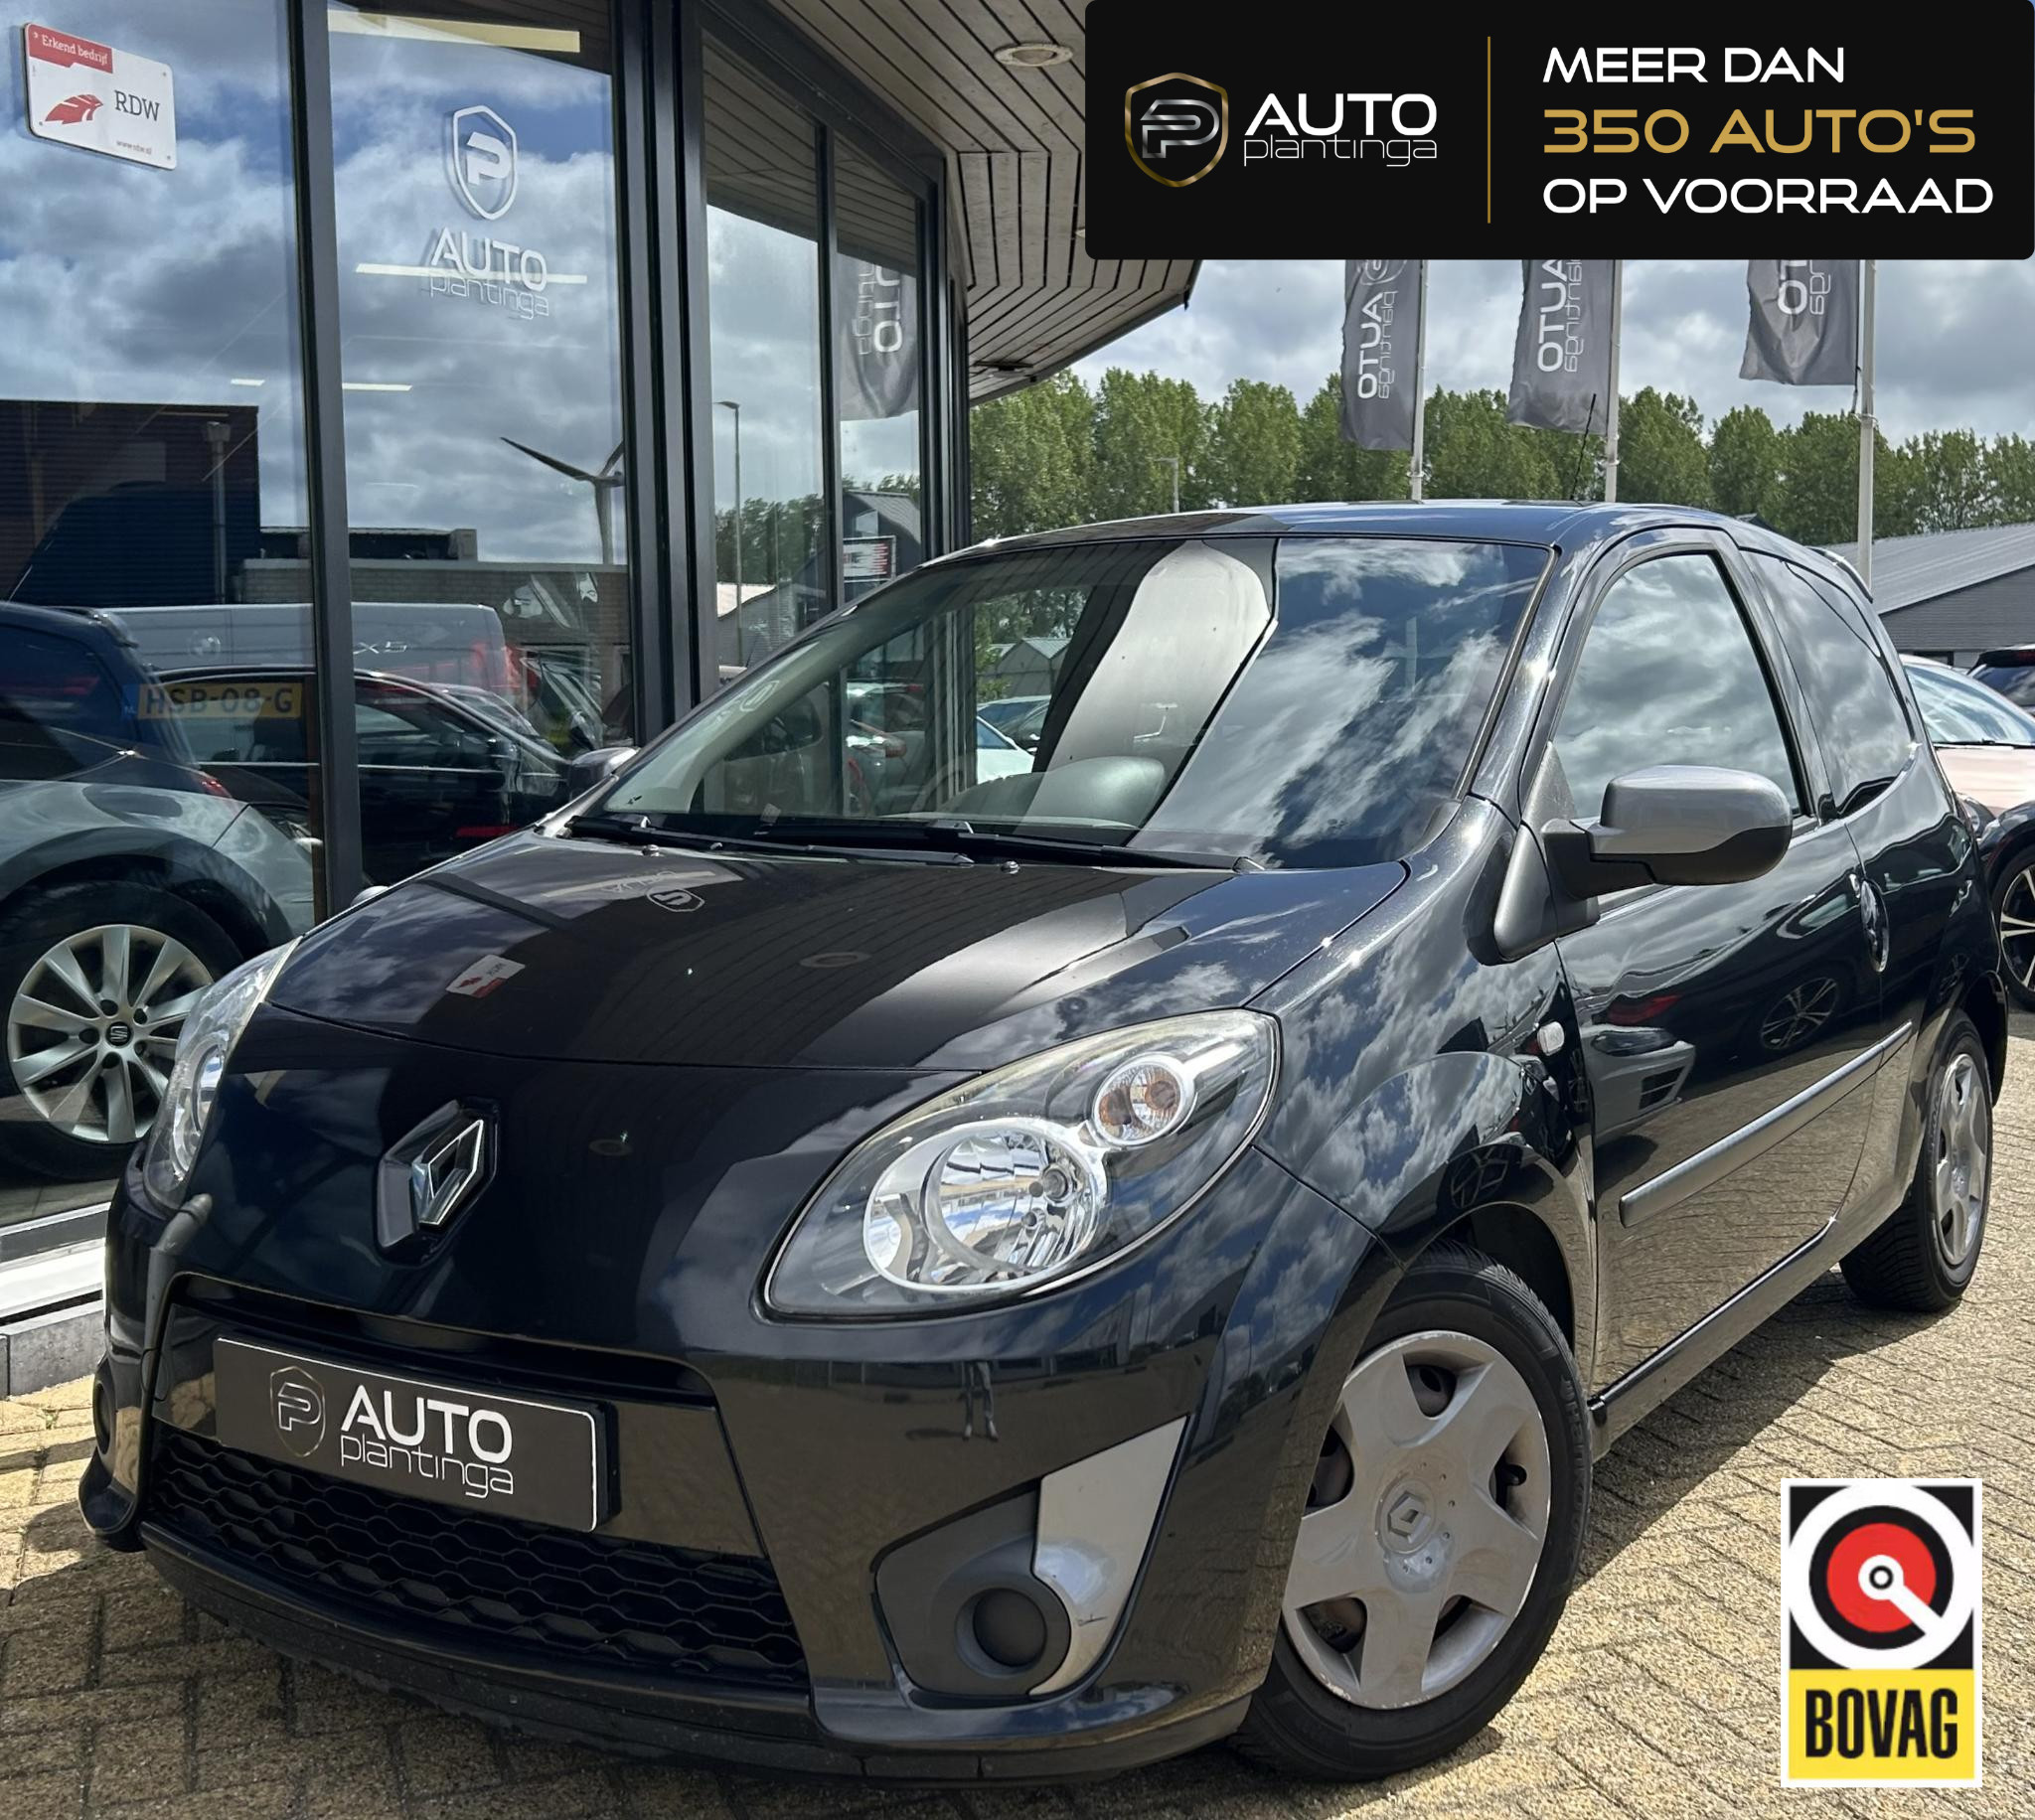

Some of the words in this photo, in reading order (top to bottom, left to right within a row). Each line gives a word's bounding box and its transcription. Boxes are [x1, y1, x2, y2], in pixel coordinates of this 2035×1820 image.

[41, 34, 77, 55] Erkend
[77, 45, 108, 67] bedrijf
[113, 89, 161, 122] RDW
[430, 227, 548, 292] AUTO
[429, 272, 549, 320] plantinga
[145, 686, 294, 714] HSB-08-G
[341, 1384, 514, 1464] AUTO
[340, 1433, 515, 1498] plantinga
